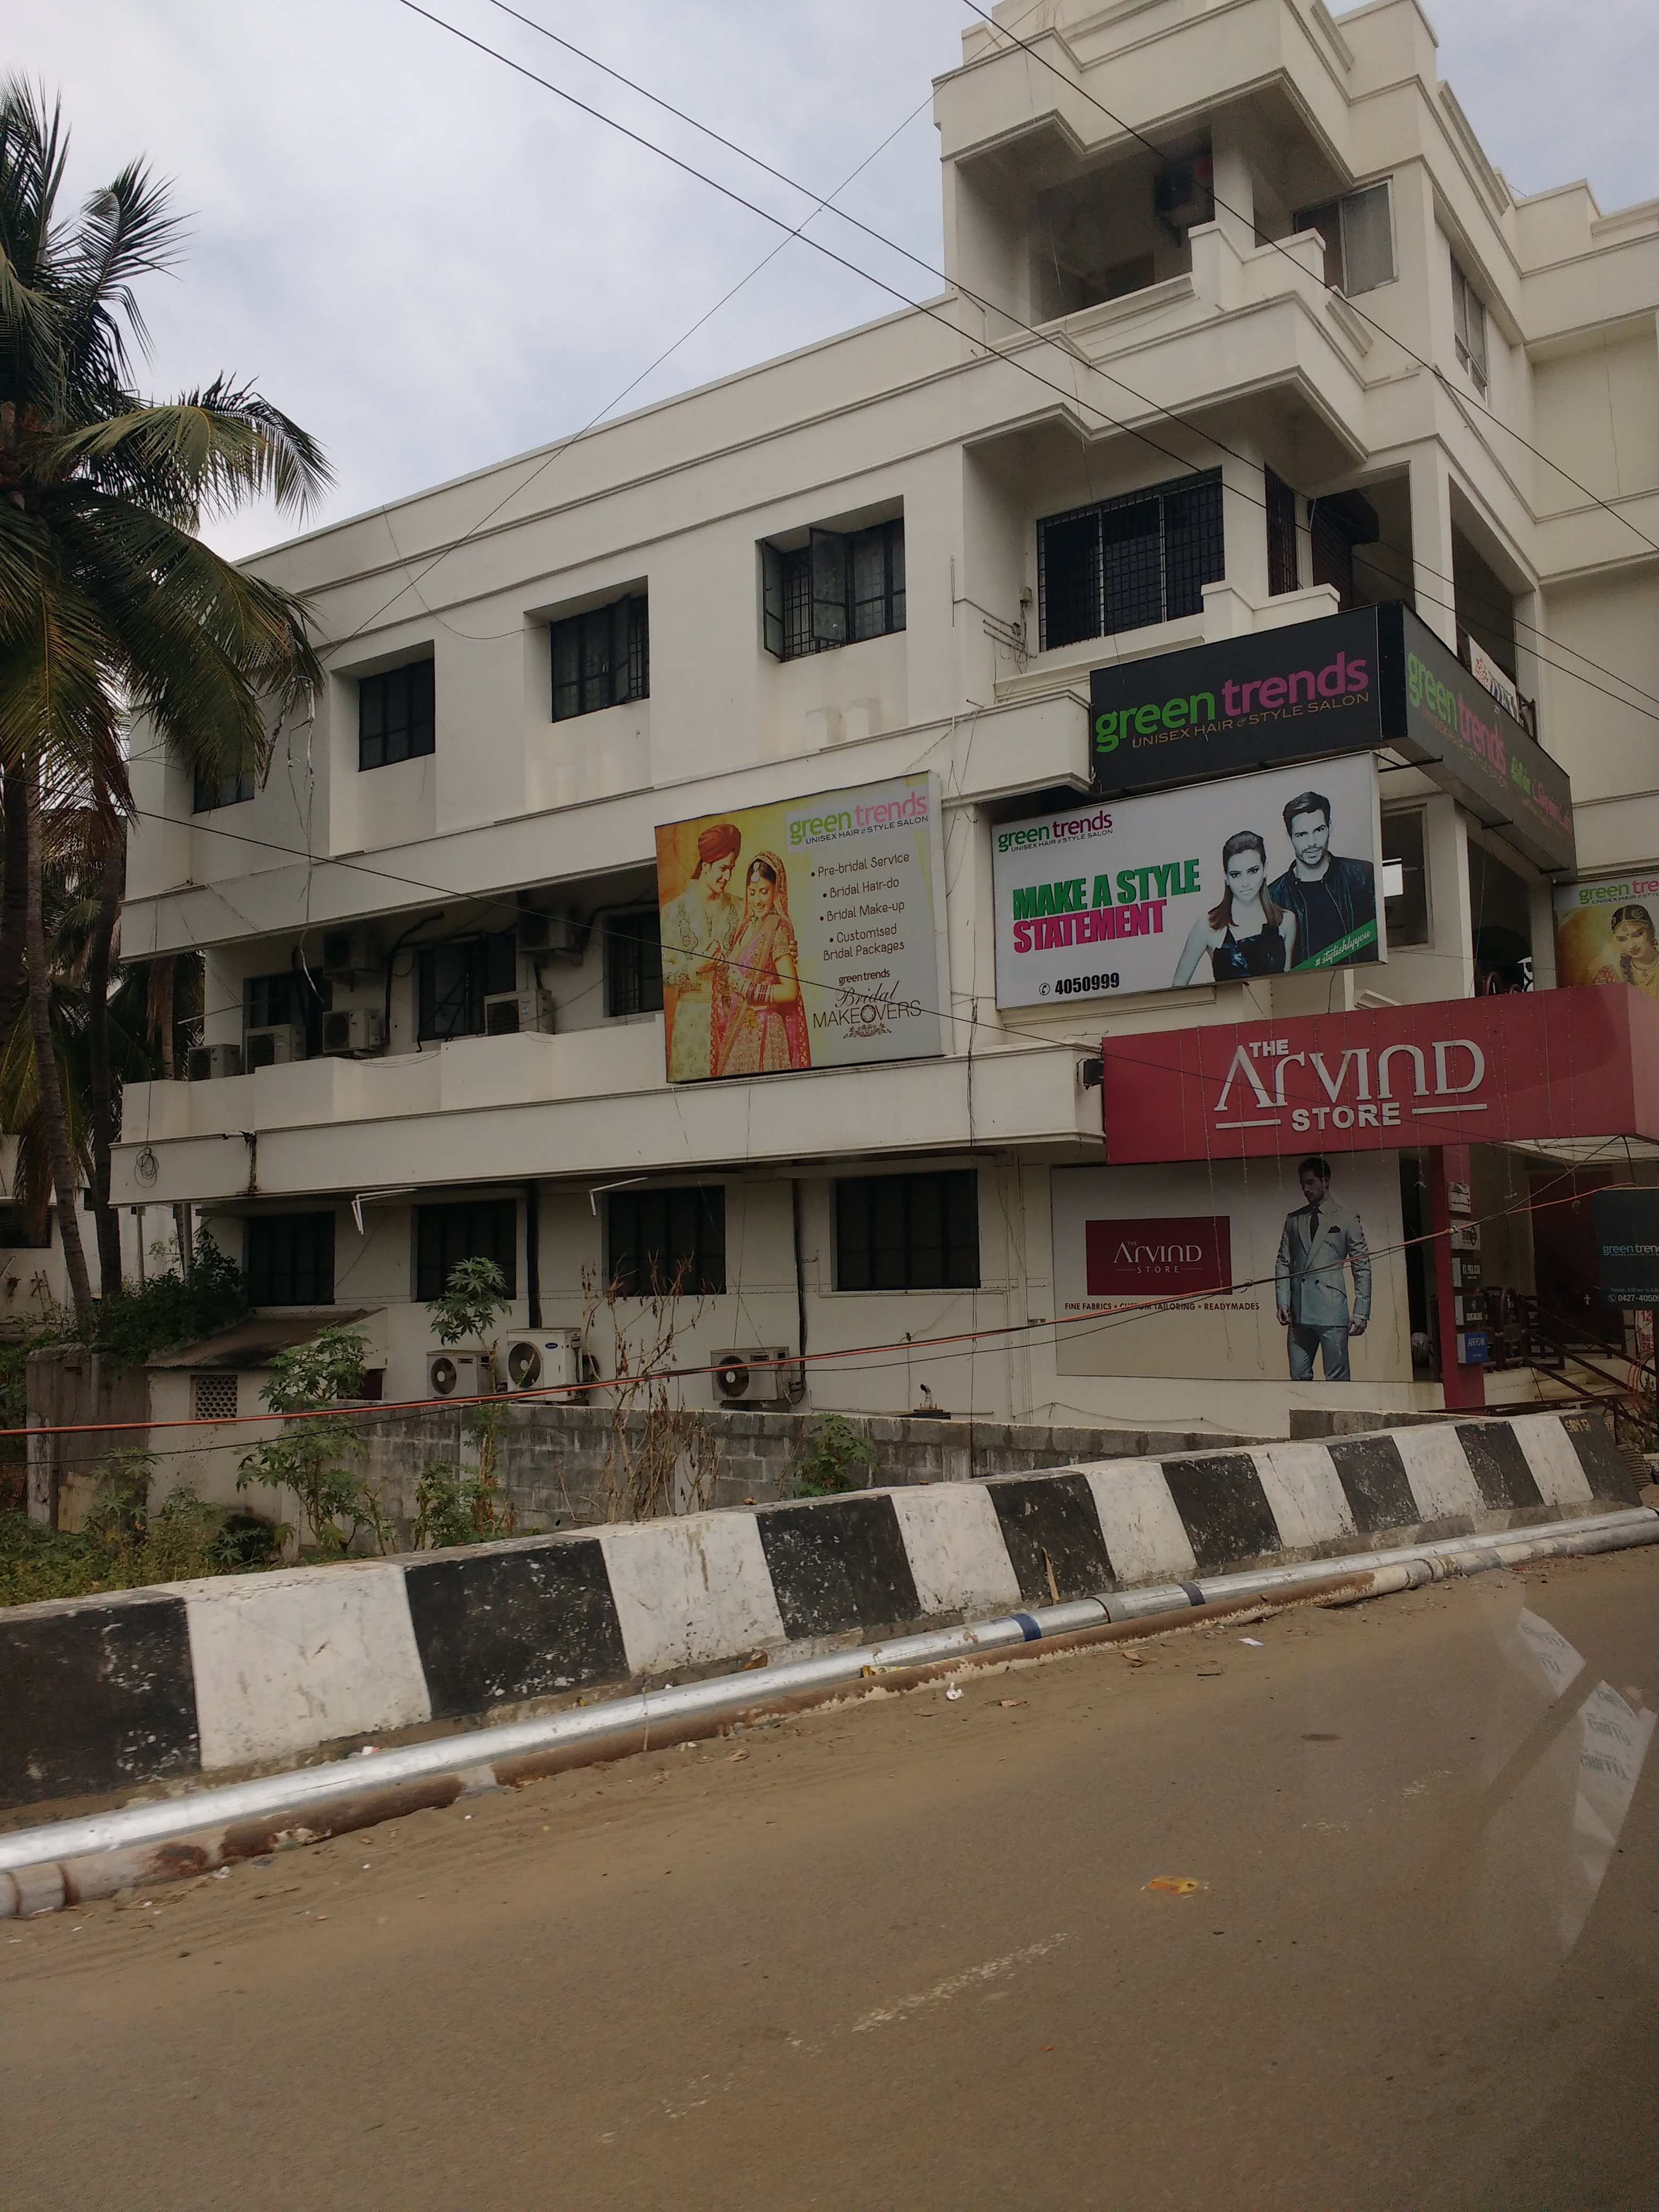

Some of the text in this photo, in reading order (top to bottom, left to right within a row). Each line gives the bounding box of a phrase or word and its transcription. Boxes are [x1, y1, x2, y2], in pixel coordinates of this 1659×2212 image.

[1095, 650, 1369, 753] green trends
[1407, 652, 1457, 732] green
[1458, 693, 1506, 775] trends
[1132, 728, 1190, 749] UNISEX
[1194, 719, 1233, 737] HAIR
[1249, 706, 1303, 725] STYLE
[1308, 692, 1369, 713] SALON
[790, 791, 927, 846] green trends
[806, 833, 837, 844] UNISEX
[839, 828, 859, 839] HAIR
[867, 822, 894, 833] STYLE
[897, 816, 928, 828] SALON
[998, 810, 1113, 853] green trends
[1010, 842, 1037, 852] UNISEX
[1038, 839, 1056, 848] HAIR
[1062, 834, 1086, 844] STYLE
[1087, 828, 1113, 840] SALON
[818, 852, 910, 878] Pre-bridal Service
[830, 878, 899, 899] Bridal Hair-do
[1013, 858, 1201, 920] MAKE A STYLE
[1579, 883, 1629, 904] green
[827, 901, 905, 922] Bridal Make-up
[836, 924, 897, 943] Customised
[1013, 899, 1167, 954] STATEMENT
[824, 942, 905, 962] Bridal Packages
[839, 969, 890, 986] green trends
[1055, 973, 1120, 995] 4050999
[835, 981, 900, 1008] Bridal
[813, 1000, 921, 1029] MAKEOVERS
[1249, 1038, 1289, 1058] THE
[1291, 1101, 1401, 1132] STORE
[1603, 1245, 1634, 1256] green
[1137, 1266, 1180, 1274] STORE
[1083, 1302, 1112, 1311] FABRICS
[1153, 1302, 1195, 1311] TAILORING
[1204, 1302, 1260, 1311] READYMADES
[1468, 1337, 1485, 1347] ARROW
